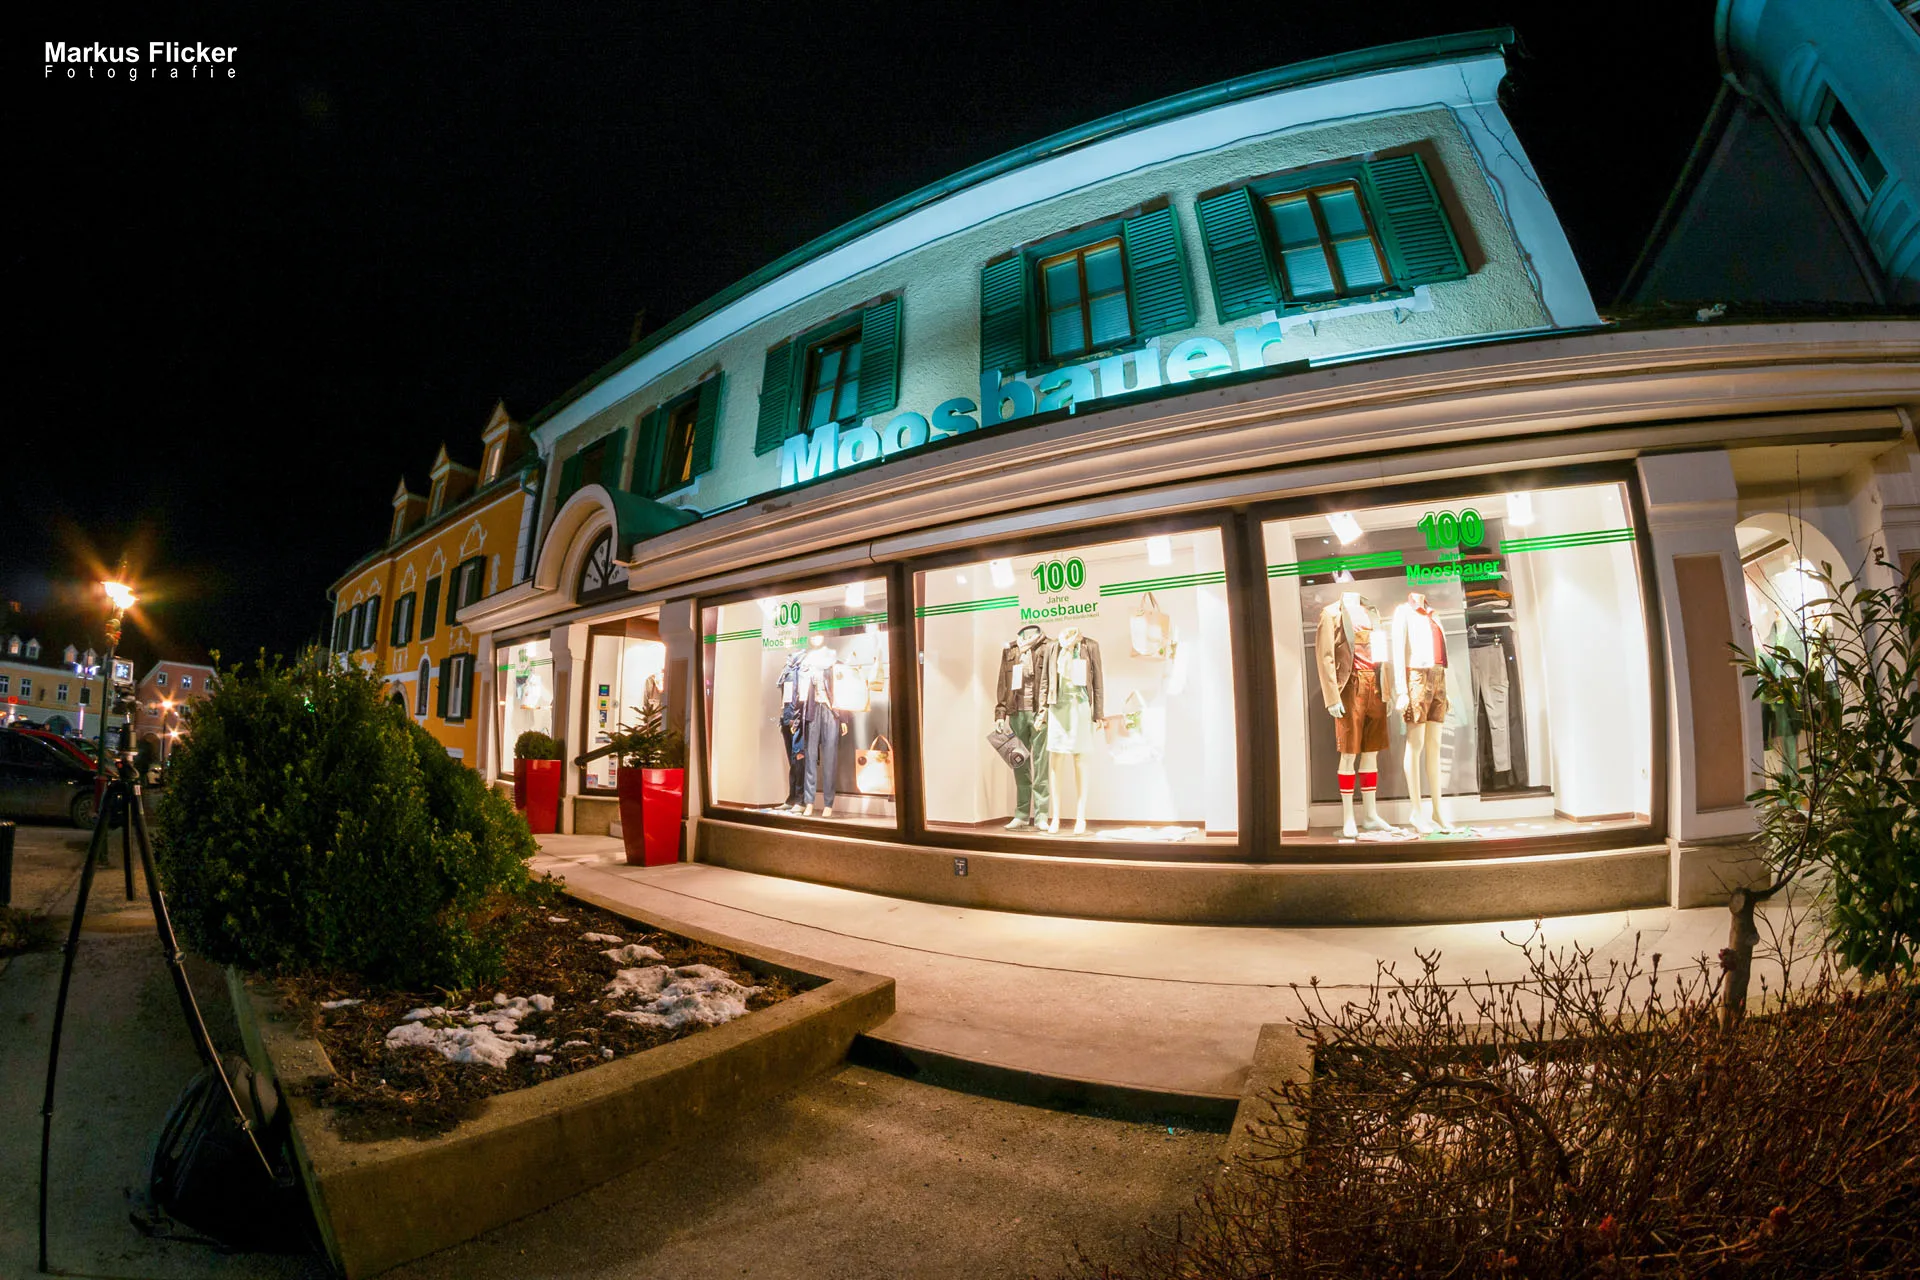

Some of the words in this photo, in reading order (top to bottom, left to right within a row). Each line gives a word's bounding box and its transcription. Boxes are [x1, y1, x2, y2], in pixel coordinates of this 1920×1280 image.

[780, 321, 1284, 488] Moosbauer
[1417, 508, 1485, 550] 100
[1031, 556, 1086, 594] 100
[1406, 560, 1500, 579] Moosbauer
[1020, 602, 1099, 620] Moosbauer
[1046, 594, 1069, 604] Jahre
